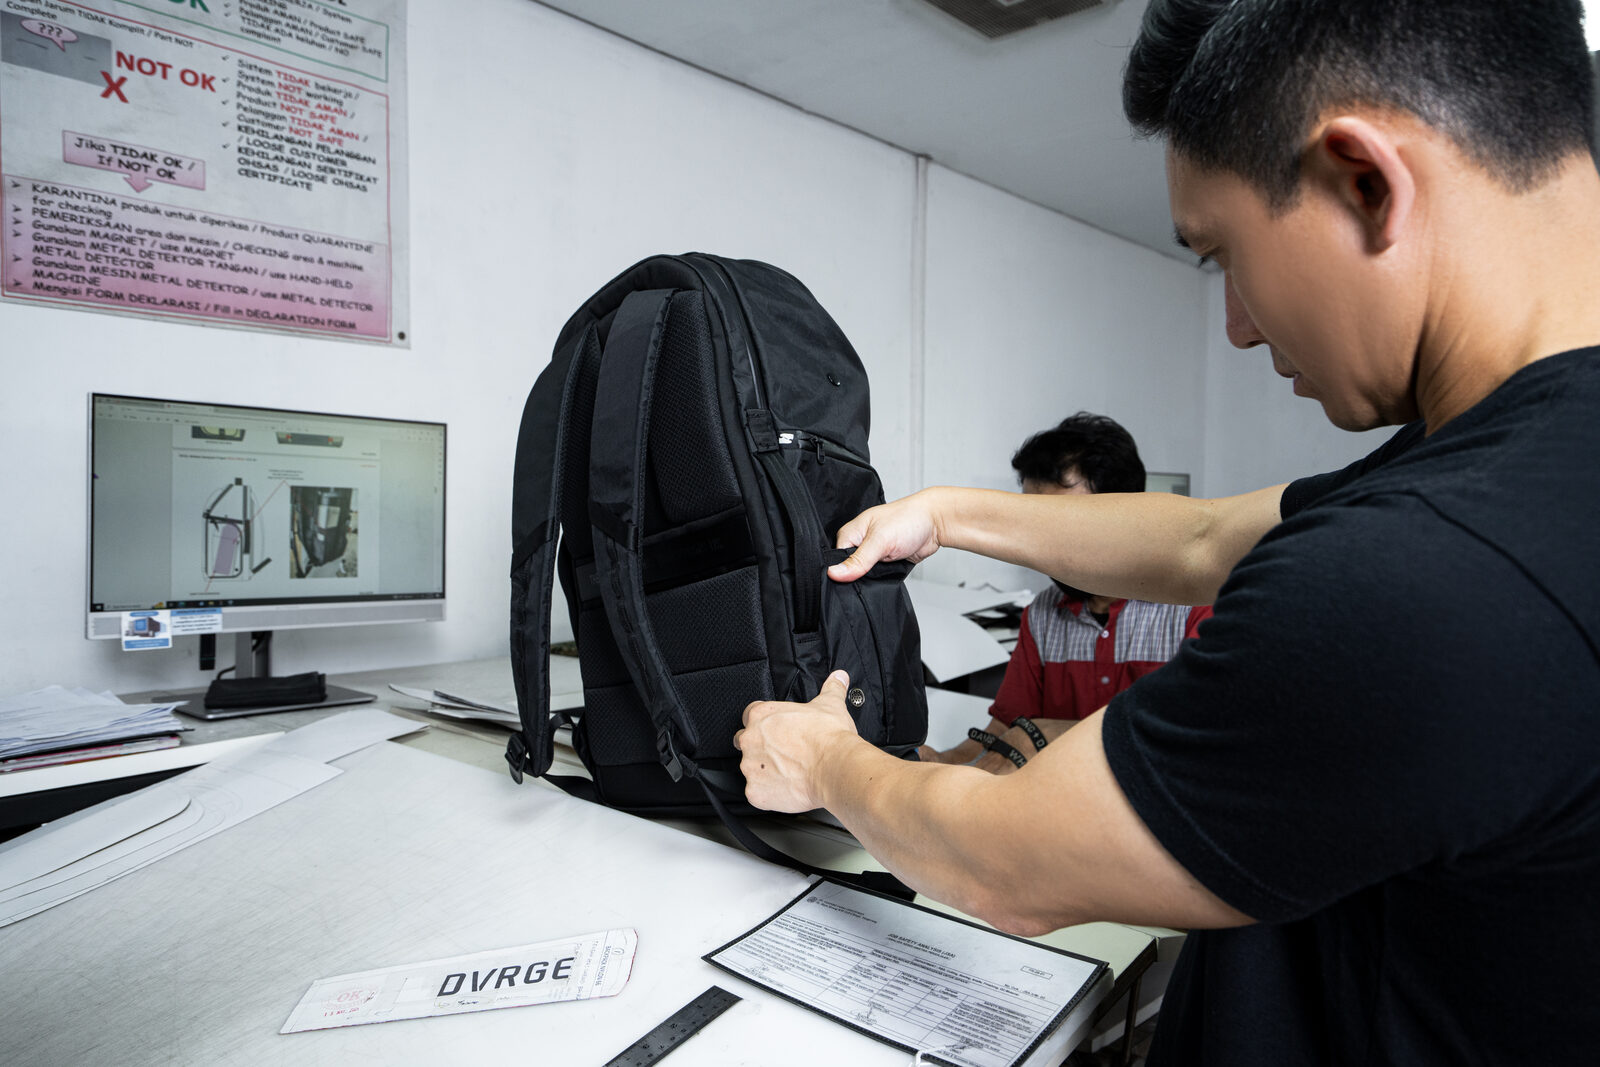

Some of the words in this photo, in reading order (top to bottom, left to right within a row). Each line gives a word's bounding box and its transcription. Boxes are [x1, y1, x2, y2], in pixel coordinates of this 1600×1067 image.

[6, 1, 58, 20] Complete
[38, 23, 63, 38] ???
[115, 50, 173, 80] NOT
[179, 68, 216, 93] OK
[237, 59, 273, 76] Sistem
[275, 70, 310, 87] TIDAK
[237, 69, 276, 88] System
[277, 82, 303, 95] NOT
[305, 91, 344, 107] working
[236, 80, 272, 97] Produk
[275, 91, 310, 107] TIDAK
[314, 103, 348, 117] AMAN
[236, 91, 277, 108] Product
[279, 104, 304, 116] NOT
[309, 111, 337, 125] SAFE
[236, 102, 288, 122] Pelanggan
[289, 116, 324, 131] TIDAK
[328, 128, 360, 141] AMAN
[237, 113, 286, 131] Customer
[288, 126, 313, 138] NOT
[318, 133, 344, 148] SAFE
[74, 136, 106, 152] Jika
[110, 144, 158, 163] TIDAK
[162, 156, 183, 169] OK
[237, 124, 313, 149] KEHILANGAN
[315, 144, 376, 165] PELANGGAN
[246, 137, 285, 153] LOOSE
[289, 147, 347, 167] CUSTOMER
[97, 154, 115, 166] If
[117, 157, 152, 174] NOT
[156, 168, 177, 181] OK
[237, 145, 313, 170] KEHILANGAN
[316, 165, 378, 184] SERTIFIKAT
[237, 157, 279, 173] OHSAS
[291, 168, 328, 184] LOOSE
[332, 178, 368, 193] OHSAS
[237, 167, 313, 192] CERTIFICATE
[31, 183, 118, 207] KARANTINA
[120, 200, 162, 217] produk
[164, 208, 197, 222] untuk
[260, 225, 300, 241] Product
[302, 233, 374, 254] QUARANTINE
[32, 195, 55, 207] for
[57, 199, 113, 219] checking
[31, 207, 133, 233] PEMERIKSAAN
[135, 227, 162, 239] area
[165, 231, 186, 242] dan
[188, 236, 221, 248] mesin
[232, 242, 289, 260] CHECKING
[292, 253, 315, 264] area
[327, 258, 364, 272] machine
[31, 219, 86, 237] Gunakan
[89, 230, 147, 247] MAGNET
[160, 242, 180, 252] use
[184, 245, 236, 260] MAGNET
[31, 245, 81, 261] METAL
[84, 252, 155, 271] DETECTOR
[31, 232, 86, 249] Gunakan
[89, 242, 137, 258] METAL
[138, 250, 205, 268] DETEKTOR
[208, 259, 259, 276] TANGAN
[269, 271, 287, 280] use
[289, 273, 354, 290] HAND-HELD
[31, 269, 102, 287] MACHINE
[31, 257, 86, 273] Gunakan
[89, 265, 137, 280] MESIN
[139, 272, 183, 287] METAL
[186, 278, 249, 296] DETEKTOR
[260, 290, 278, 300] use
[281, 292, 317, 306] METAL
[320, 298, 373, 313] DETECTOR
[32, 281, 83, 297] Mengisi
[85, 287, 125, 301] FORM
[128, 293, 201, 311] DEKLARASI
[213, 304, 231, 315] Fill
[233, 306, 244, 315] in
[246, 308, 326, 326] DECLARATION
[327, 319, 357, 330] FORM
[437, 957, 575, 997] DVRGE
